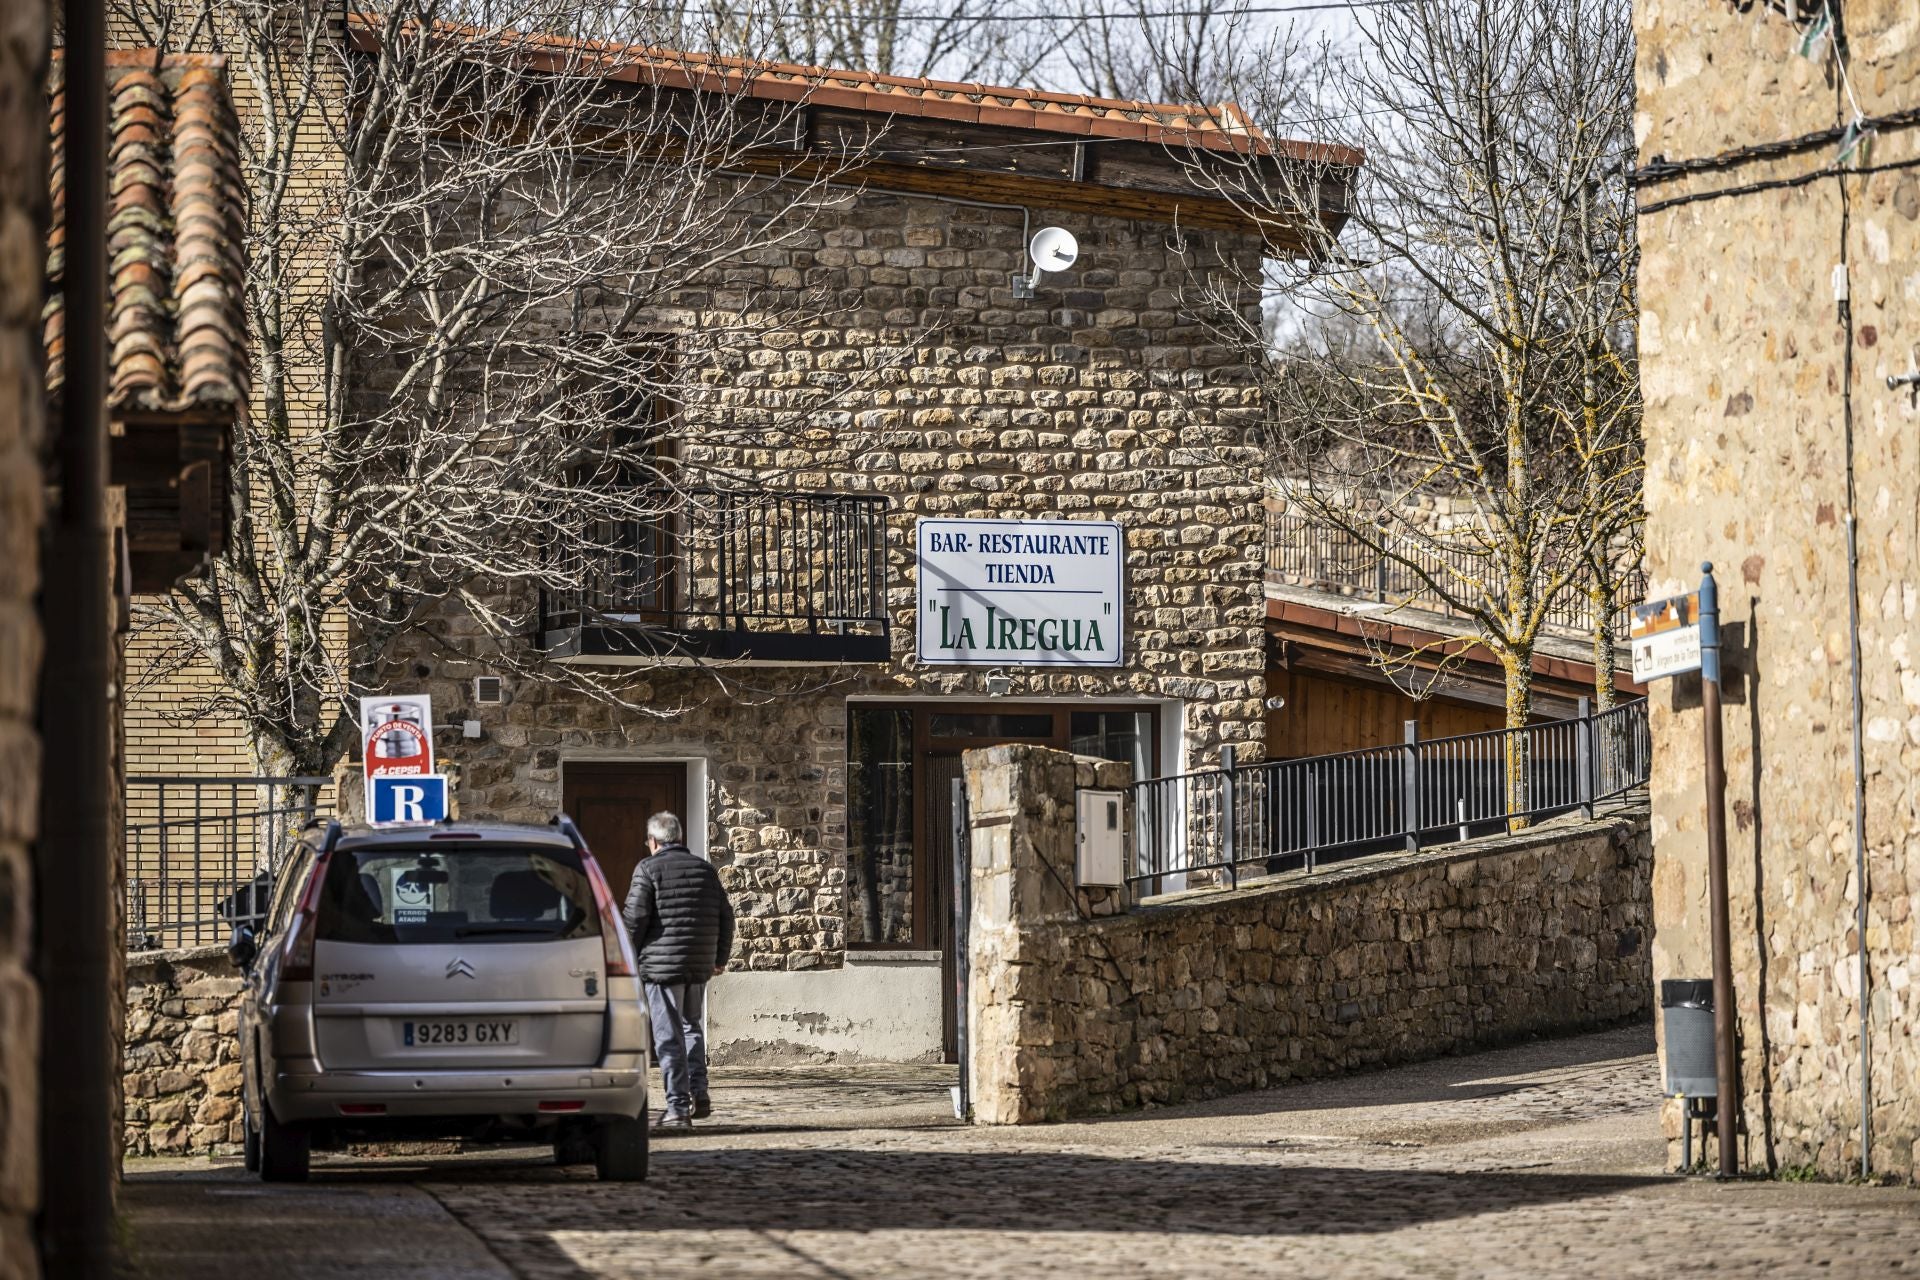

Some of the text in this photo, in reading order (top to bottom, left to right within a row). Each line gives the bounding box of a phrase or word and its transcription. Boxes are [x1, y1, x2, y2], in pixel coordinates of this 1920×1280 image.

[930, 532, 1109, 555] BAR- RESTAURANTE
[985, 564, 1055, 584] TIENDA
[371, 721, 422, 743] PUNTO DE VENTA
[388, 765, 421, 775] CEPSA
[390, 785, 425, 821] R
[418, 1024, 468, 1043] 9283
[475, 1023, 512, 1042] GXY
